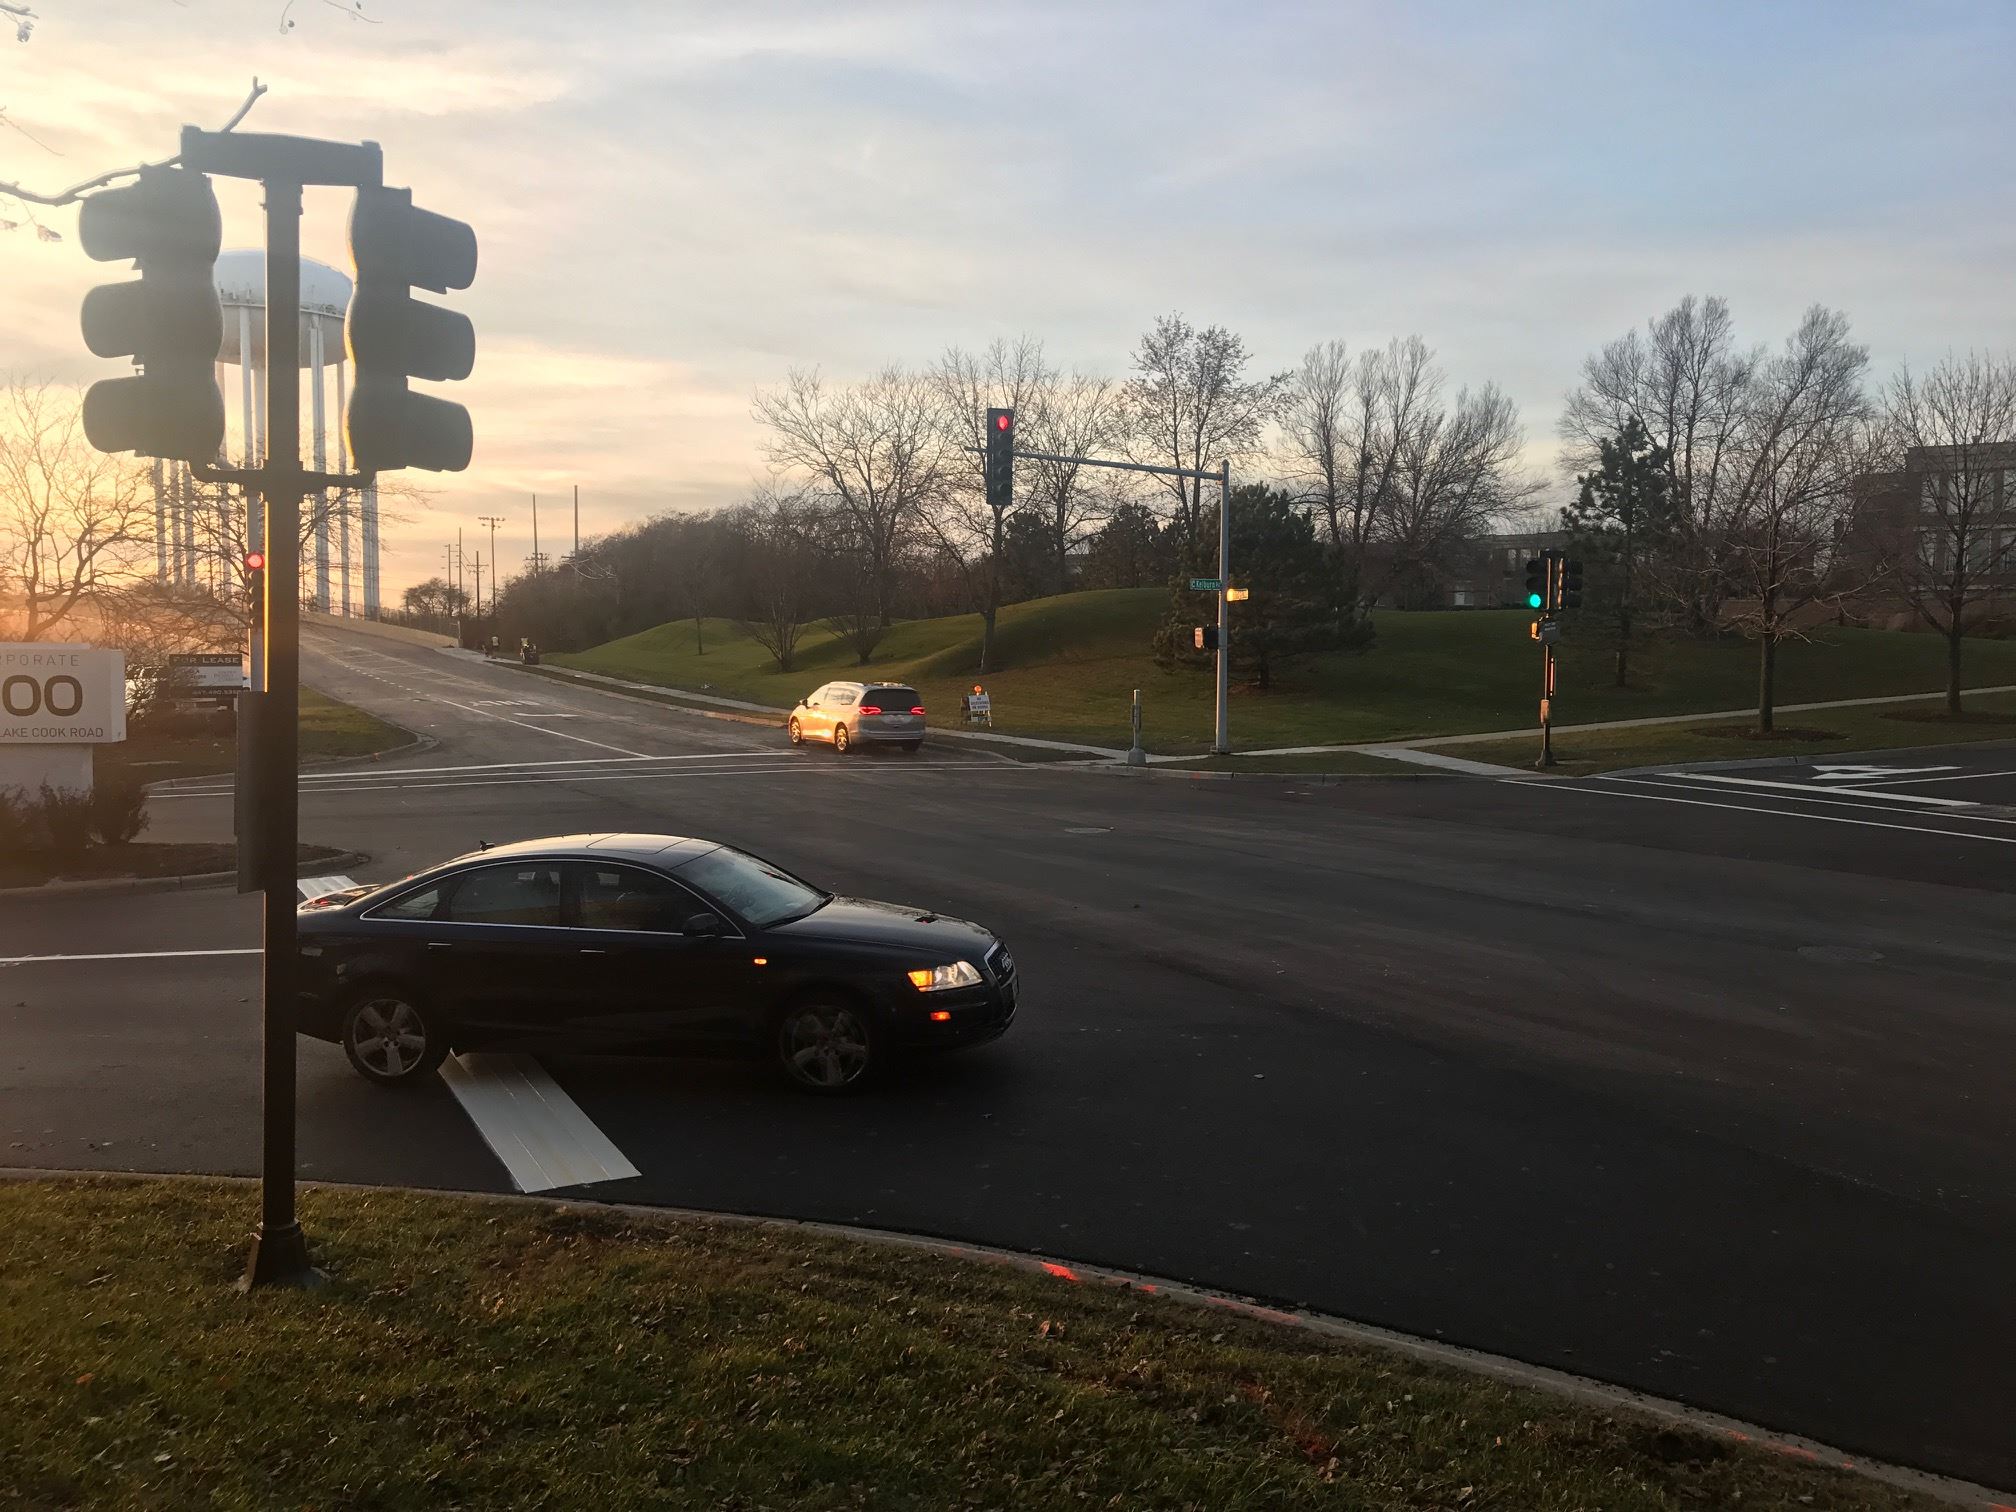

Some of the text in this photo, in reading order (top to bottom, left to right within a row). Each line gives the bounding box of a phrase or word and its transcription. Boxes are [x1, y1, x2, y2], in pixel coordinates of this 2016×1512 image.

[0, 654, 80, 666] PORATE
[32, 727, 66, 738] COOK
[70, 727, 104, 738] ROAD
